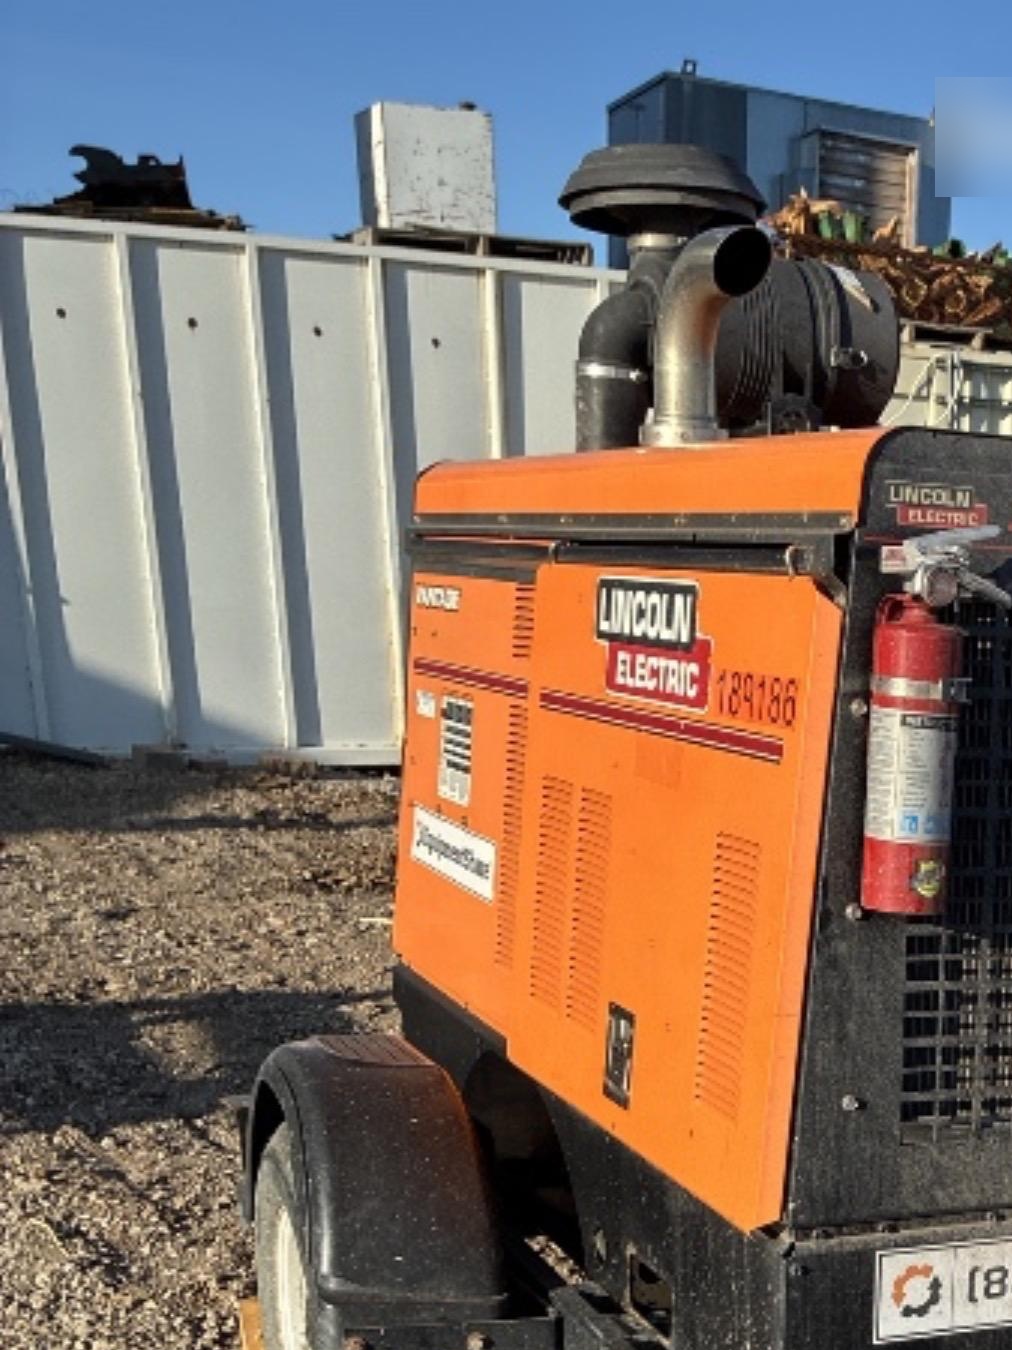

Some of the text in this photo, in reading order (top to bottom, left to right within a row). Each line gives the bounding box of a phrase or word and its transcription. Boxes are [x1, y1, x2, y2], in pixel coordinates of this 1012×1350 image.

[889, 484, 970, 508] LINCOLN
[908, 509, 978, 526] ELECTRIC
[600, 587, 693, 643] LINCOLN
[615, 650, 700, 698] ELECTRIC
[716, 668, 799, 728] 189186
